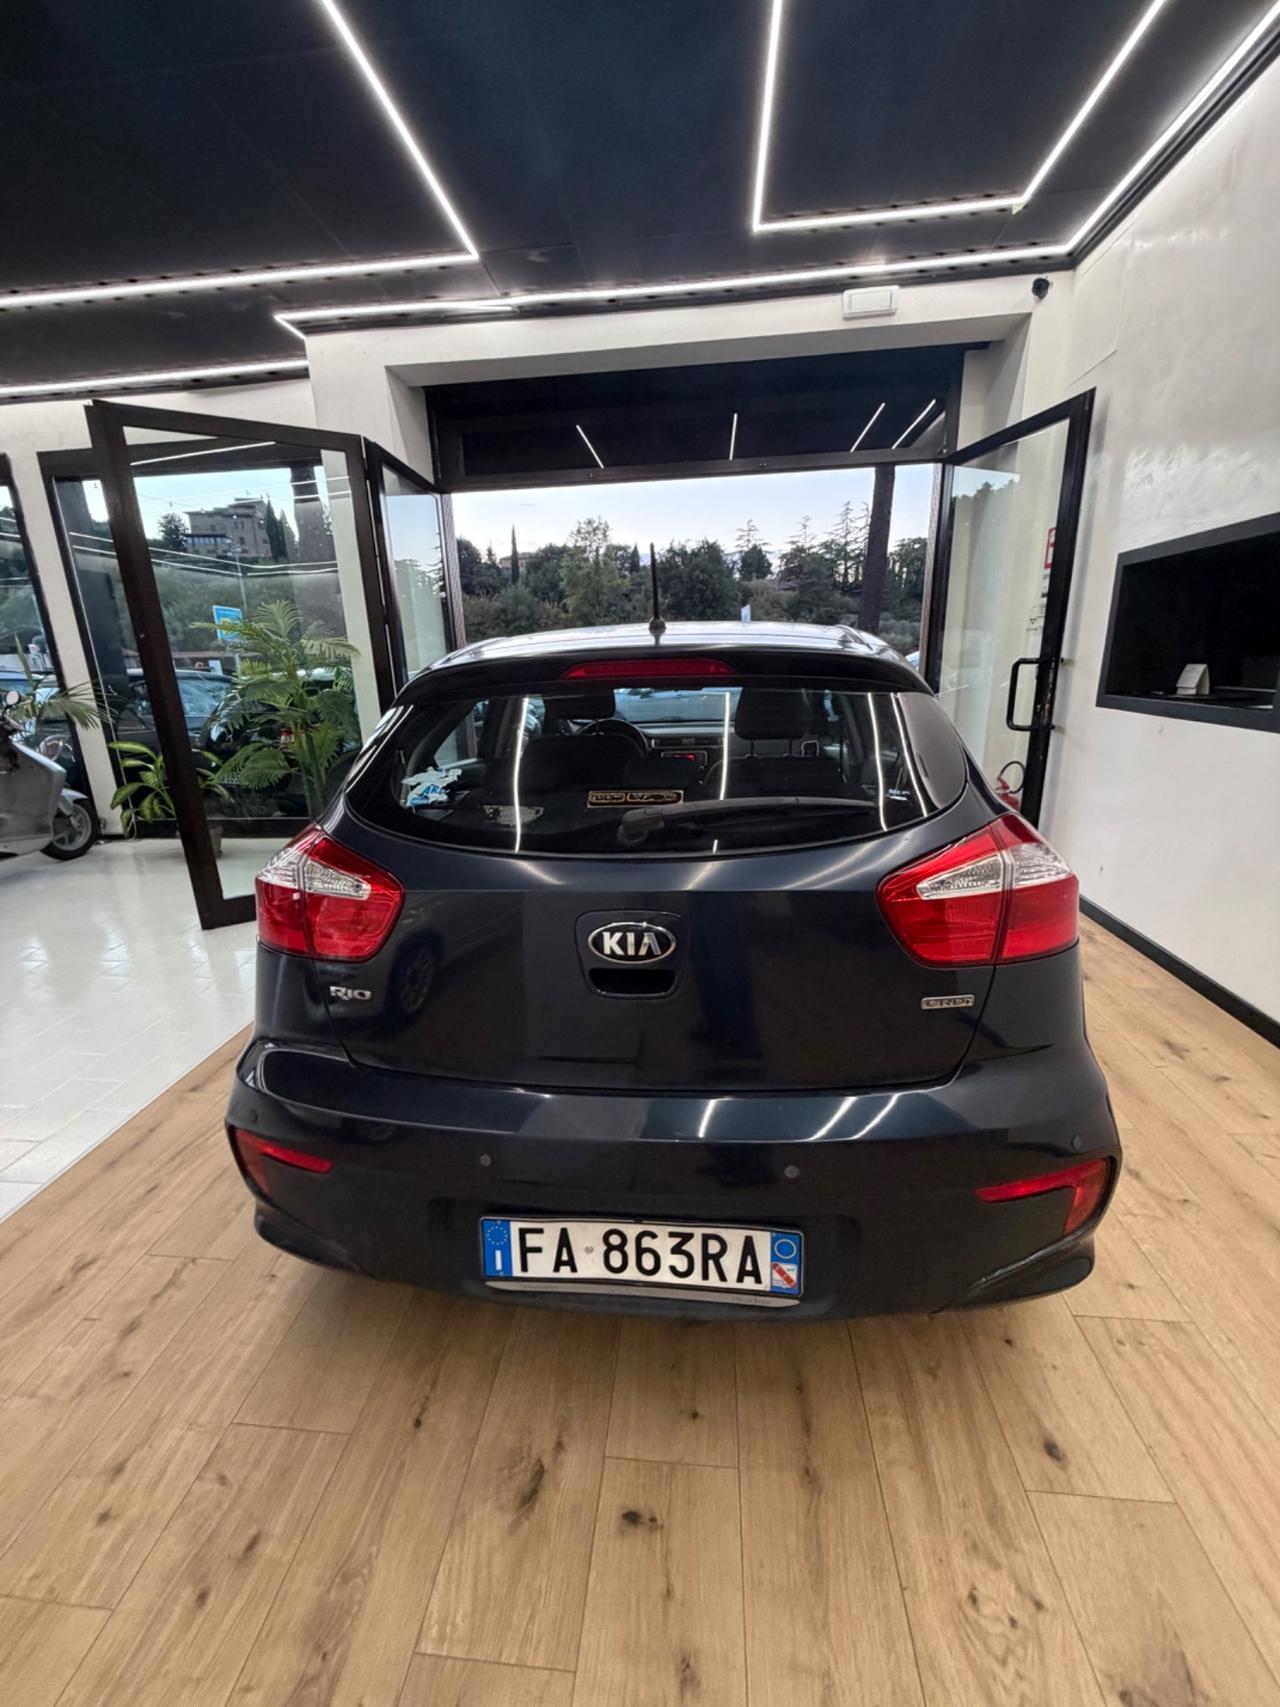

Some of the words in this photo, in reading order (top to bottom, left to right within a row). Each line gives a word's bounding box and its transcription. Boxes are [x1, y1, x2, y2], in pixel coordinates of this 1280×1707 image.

[602, 932, 661, 956] KIA
[518, 1227, 578, 1274] FA
[602, 1228, 763, 1285] 863RA
